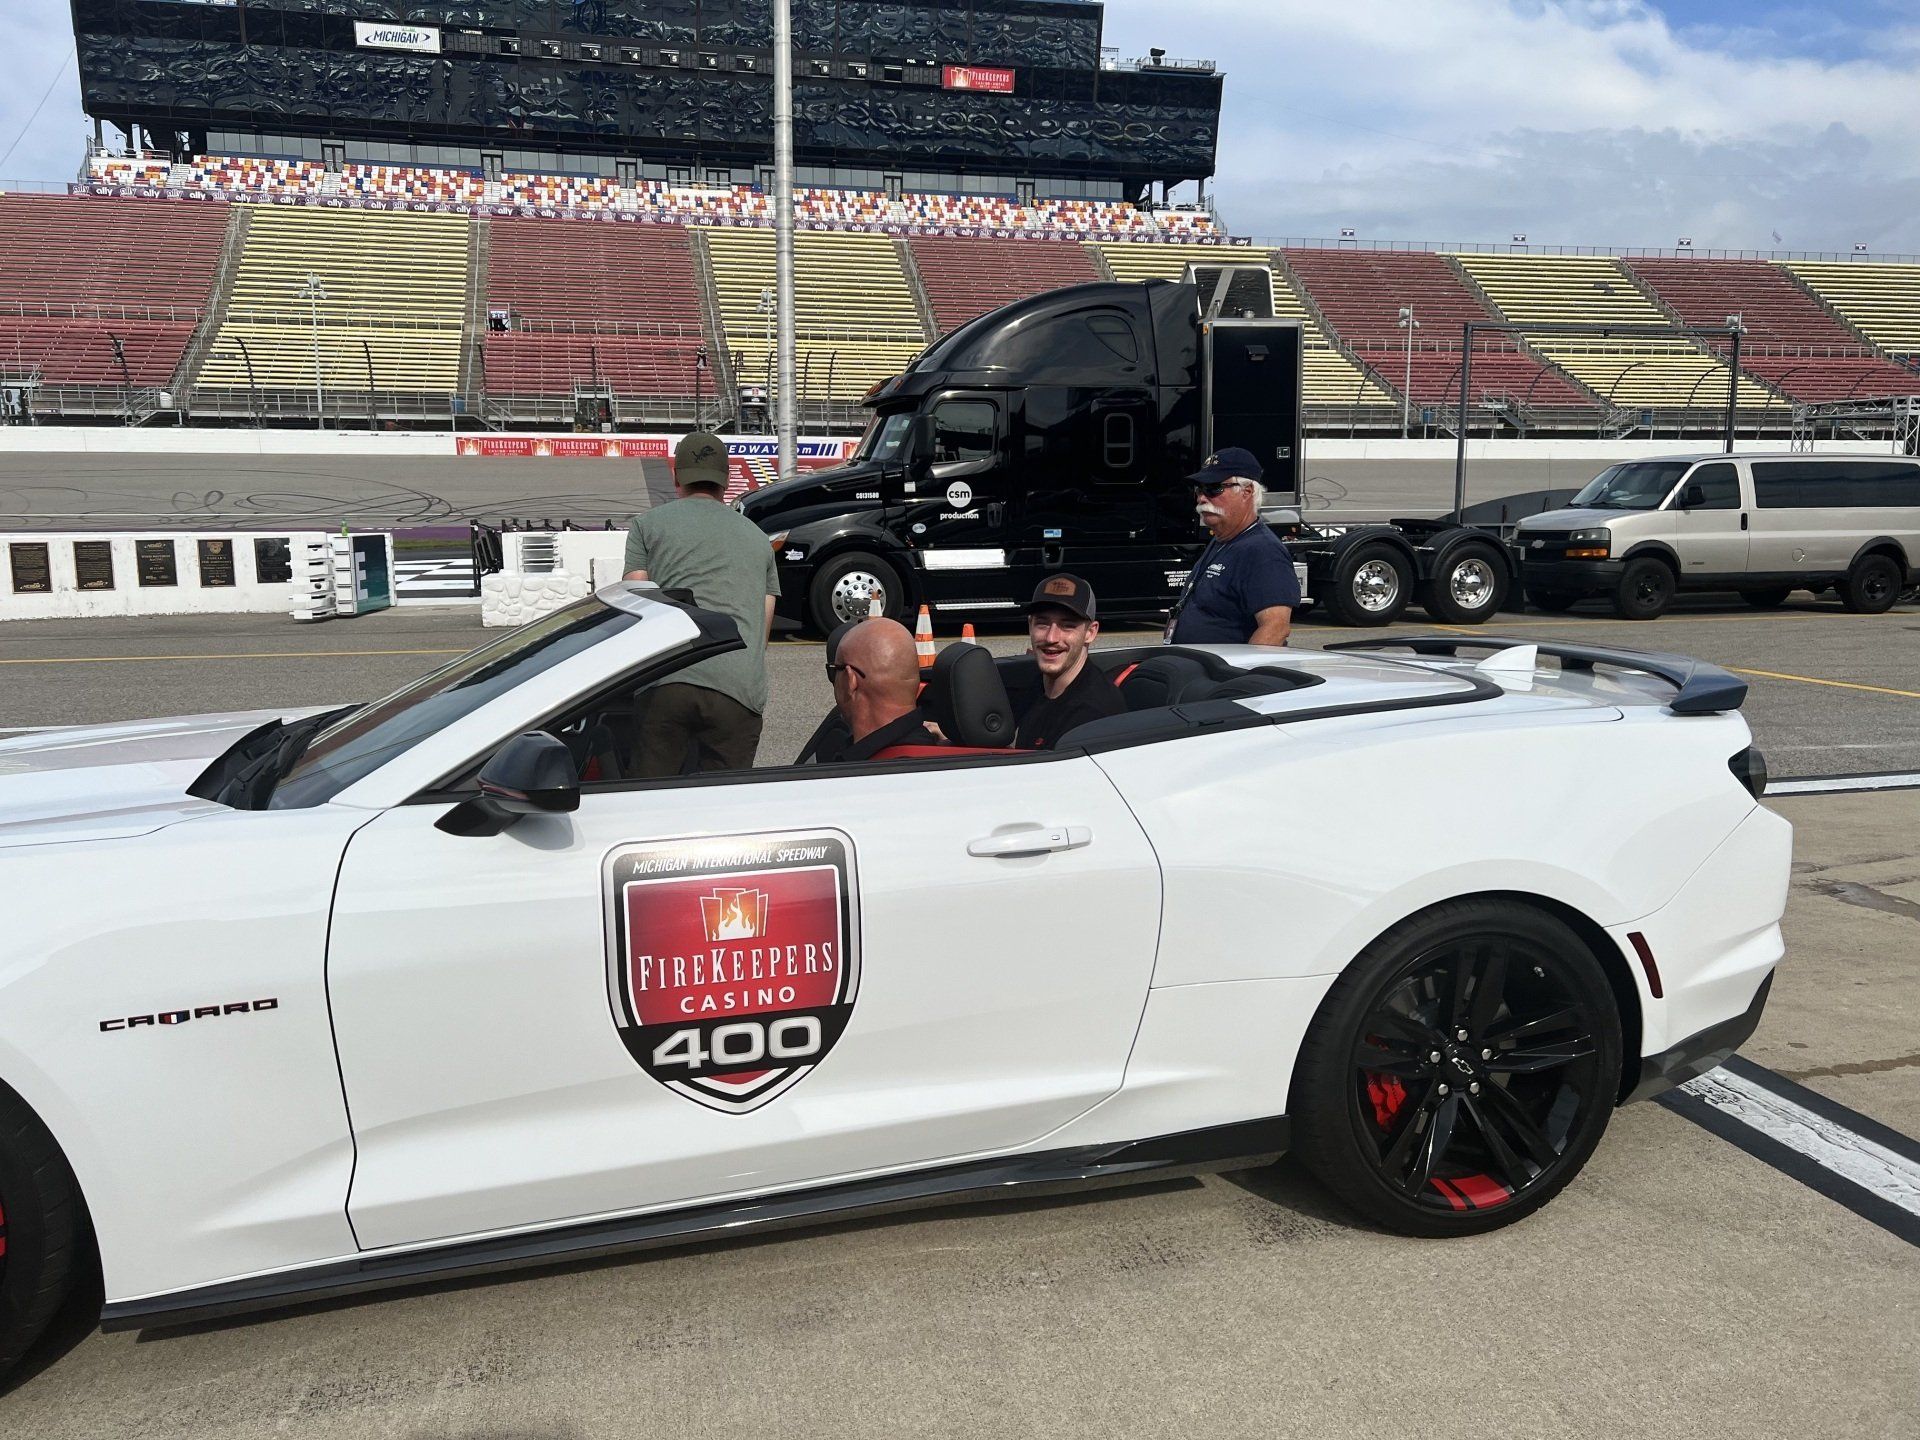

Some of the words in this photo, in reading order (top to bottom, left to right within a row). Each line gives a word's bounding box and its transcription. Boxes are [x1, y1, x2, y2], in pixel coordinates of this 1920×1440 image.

[373, 30, 419, 44] MICHIGAN
[553, 46, 559, 54] 2
[593, 49, 599, 57] 3
[632, 52, 638, 60] 4
[710, 57, 716, 65] 6
[858, 67, 866, 75] 10
[972, 71, 1010, 82] FIREKEEPERS
[96, 186, 113, 196] ally
[143, 187, 160, 198] ally
[189, 190, 206, 201] ally
[235, 193, 251, 203] ally
[280, 195, 296, 206] ally
[327, 199, 343, 209] ally
[371, 200, 387, 211] ally
[414, 202, 429, 212] ally
[456, 205, 471, 215] ally
[497, 206, 513, 216] ally
[541, 209, 556, 218] ally
[581, 211, 596, 221] ally
[621, 214, 636, 223] ally
[661, 215, 675, 225] ally
[700, 217, 714, 227] ally
[739, 219, 753, 228] ally
[814, 223, 828, 232] ally
[852, 224, 865, 233] ally
[888, 226, 901, 235] ally
[483, 440, 528, 449] FIREKEEPERS
[555, 441, 599, 450] FIREKEEPERS
[625, 442, 667, 450] FIREKEEPERS
[949, 489, 970, 499] csm
[940, 512, 979, 520] production
[632, 858, 688, 874] MICHIGAN
[692, 851, 772, 869] INTERNATIONAL
[776, 846, 828, 863] SPEEDWAY
[638, 941, 833, 991] FIREKEEPERS
[680, 986, 796, 1014] CASINO
[100, 998, 278, 1032] CAARO
[652, 1016, 822, 1070] 400
